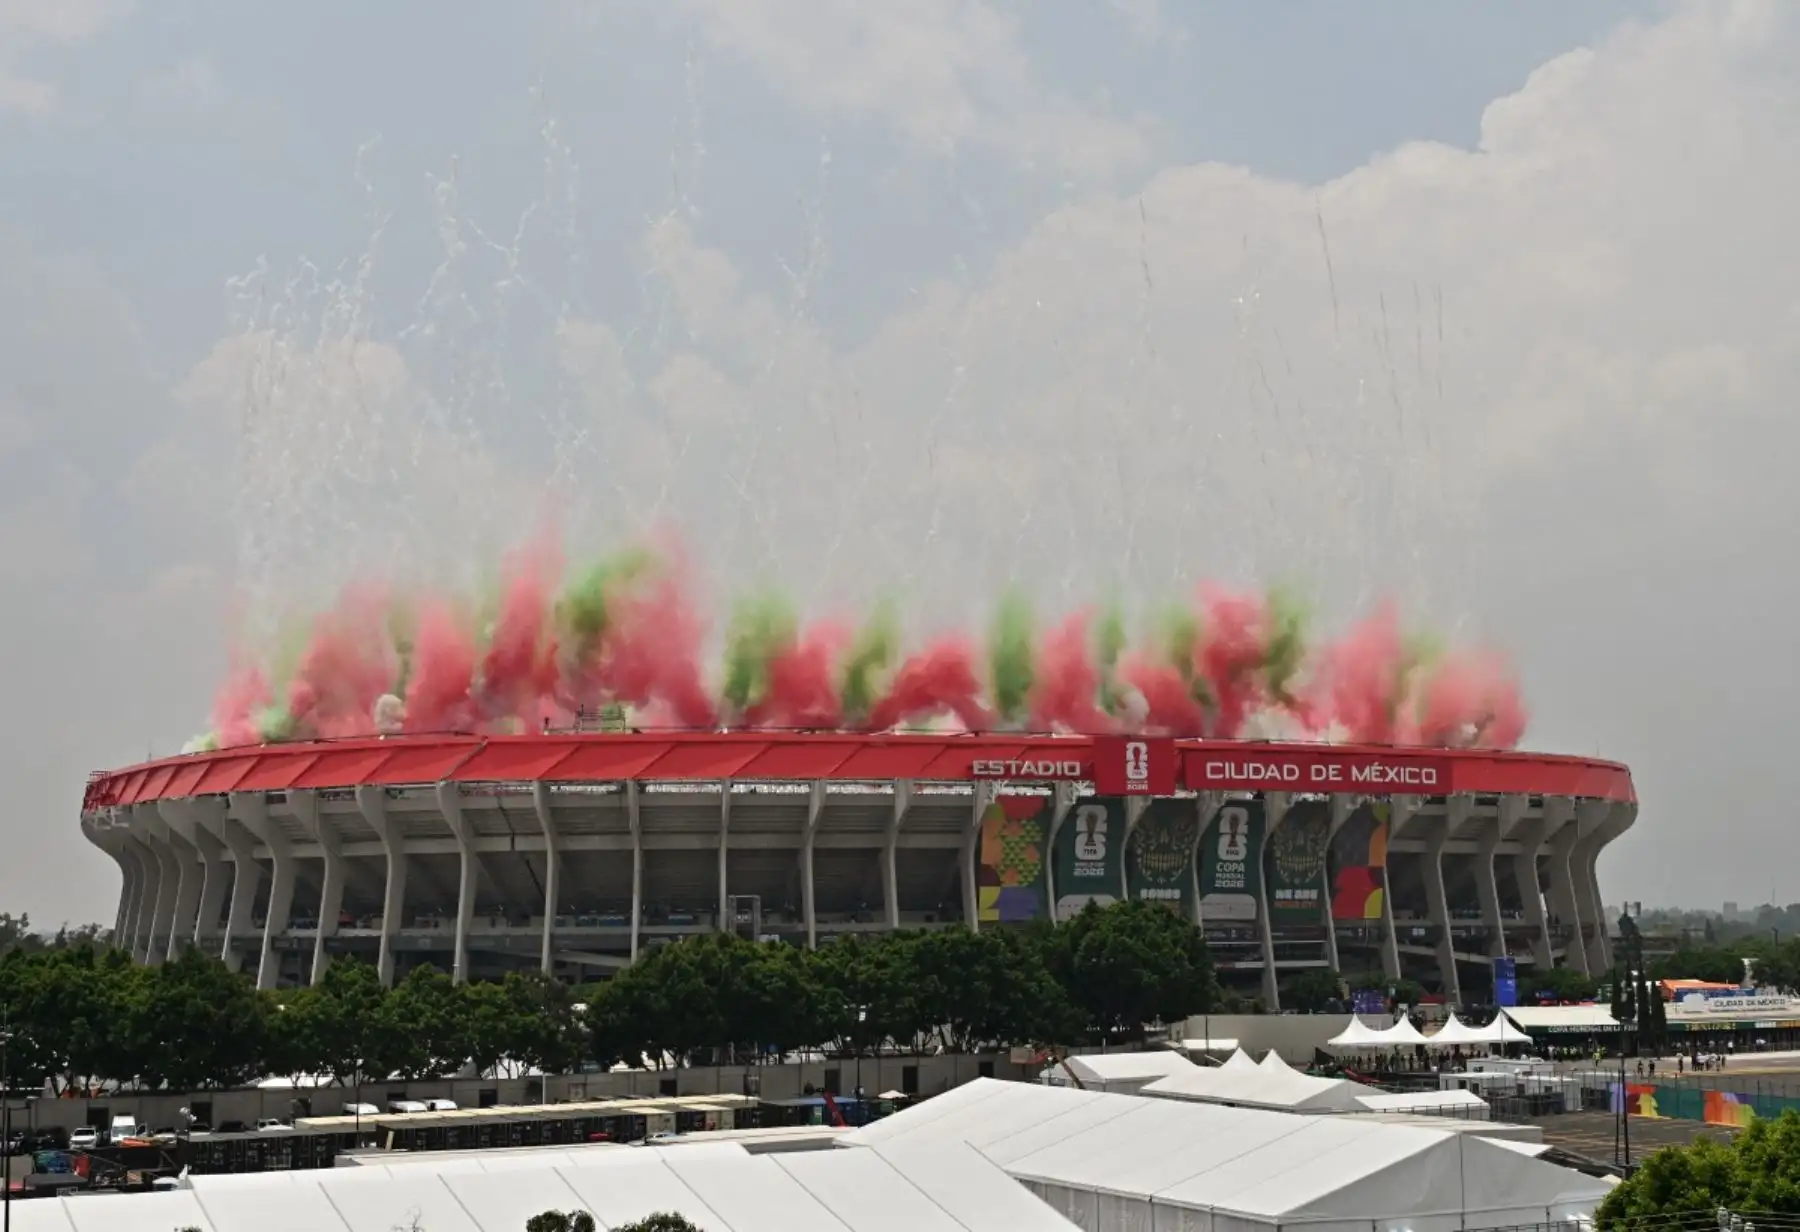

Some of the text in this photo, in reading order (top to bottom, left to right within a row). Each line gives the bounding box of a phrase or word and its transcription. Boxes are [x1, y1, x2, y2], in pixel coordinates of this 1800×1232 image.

[972, 760, 1081, 776] ESTADIO
[1206, 761, 1437, 784] CIUDAD DE MÉXICO
[1073, 867, 1105, 877] 2026
[1216, 862, 1245, 873] COPA
[1214, 879, 1245, 888] 2026
[1714, 999, 1743, 1007] CIUDAD
